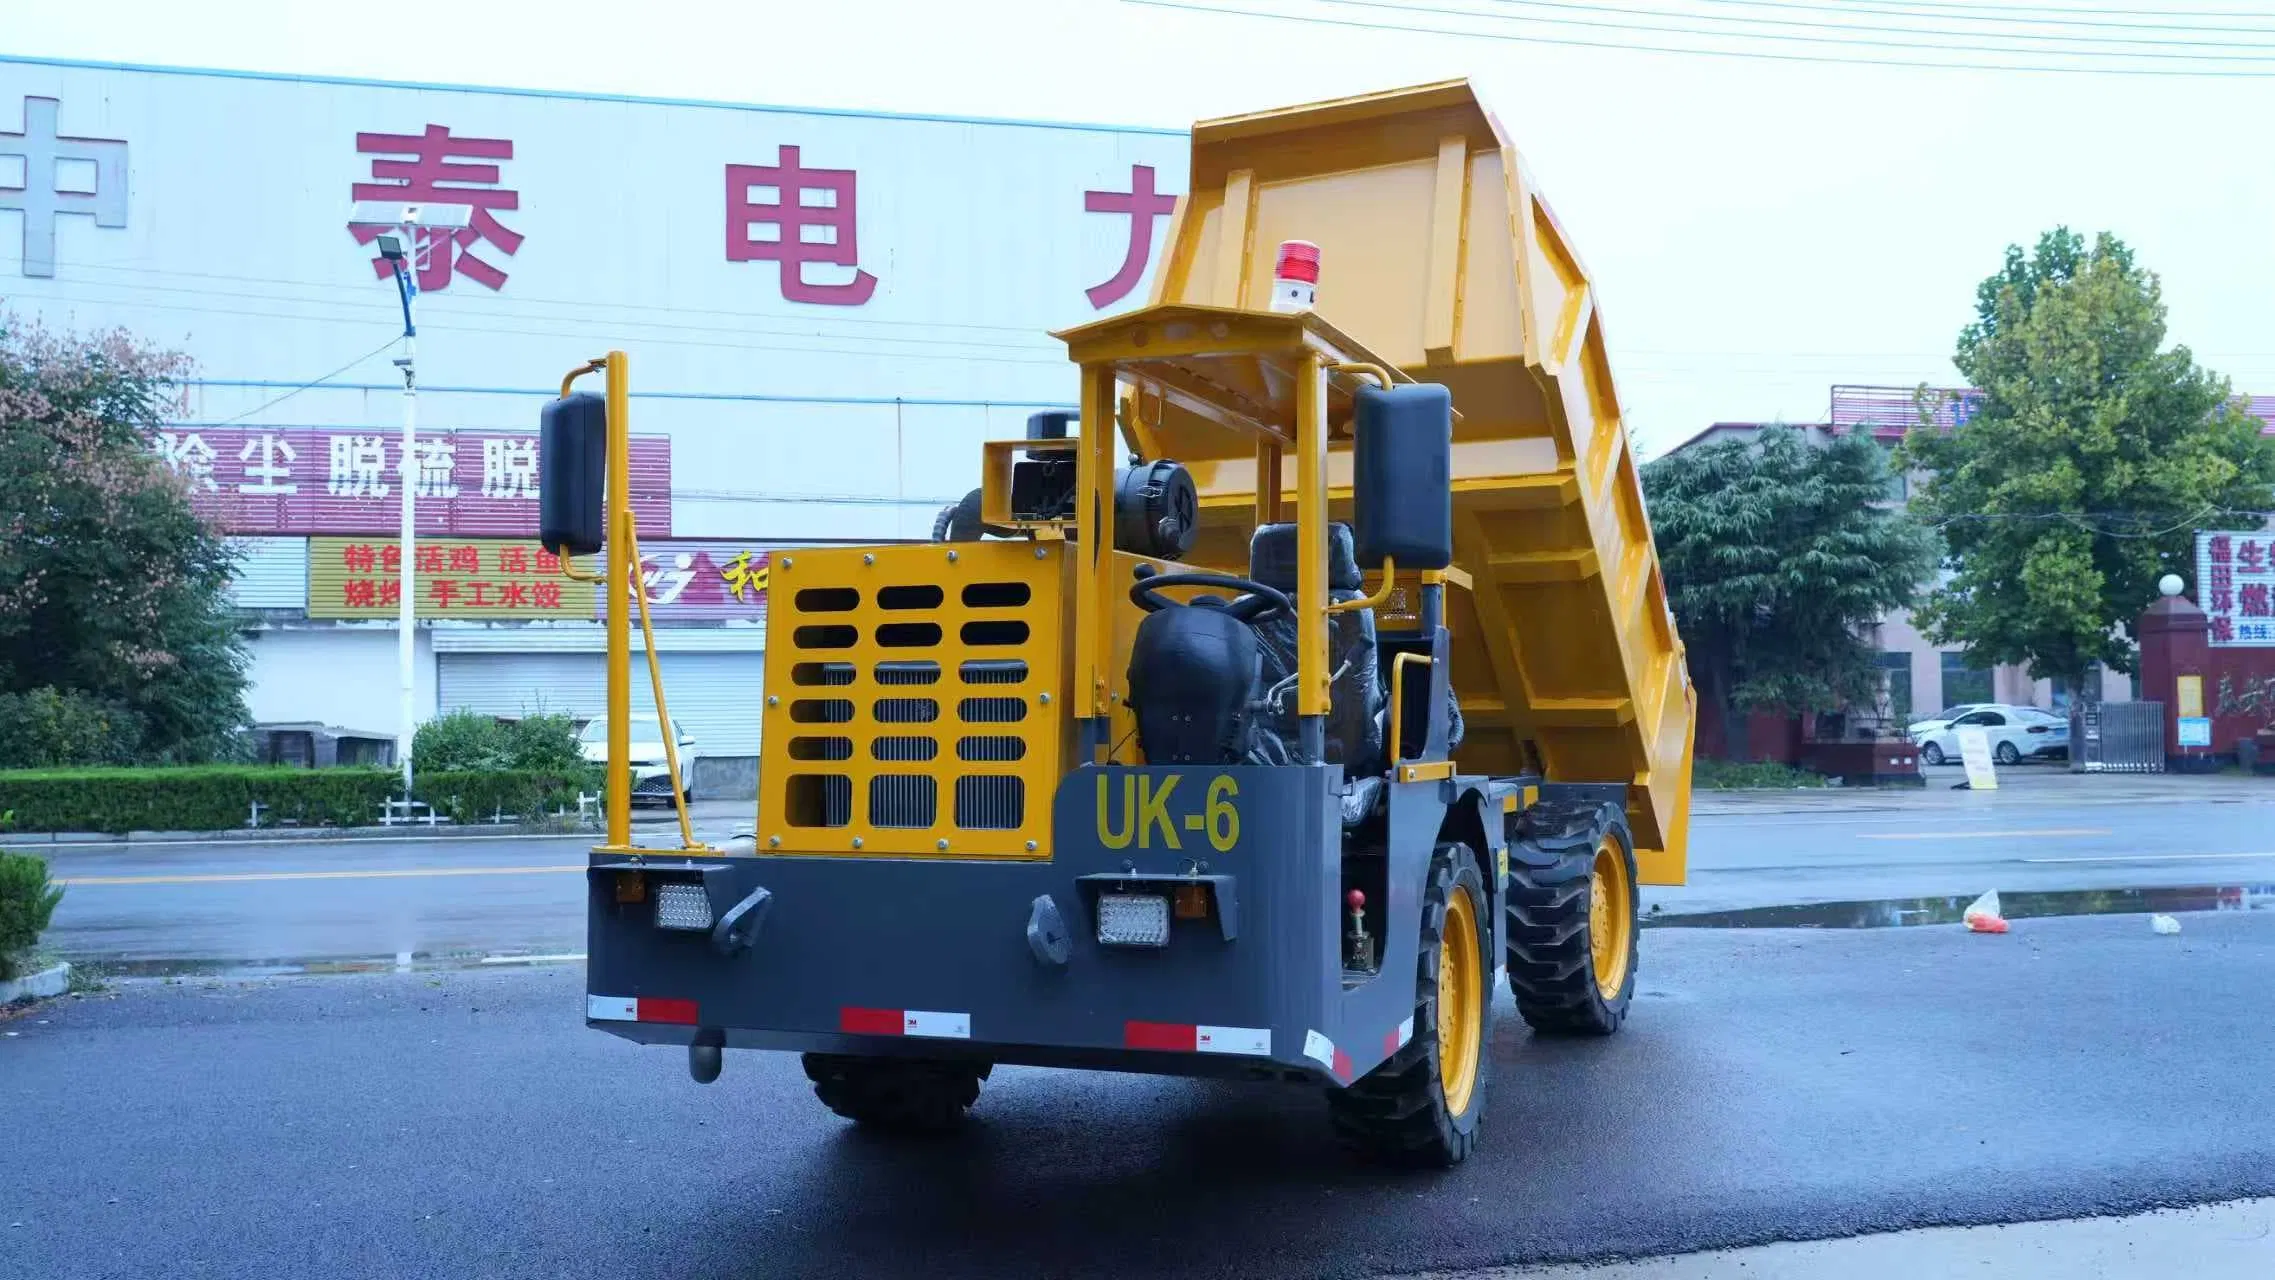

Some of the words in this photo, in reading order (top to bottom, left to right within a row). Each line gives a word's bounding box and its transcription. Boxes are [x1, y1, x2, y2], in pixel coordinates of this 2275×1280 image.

[429, 580, 561, 609] 手工水饺
[1096, 774, 1240, 852] UK-6
